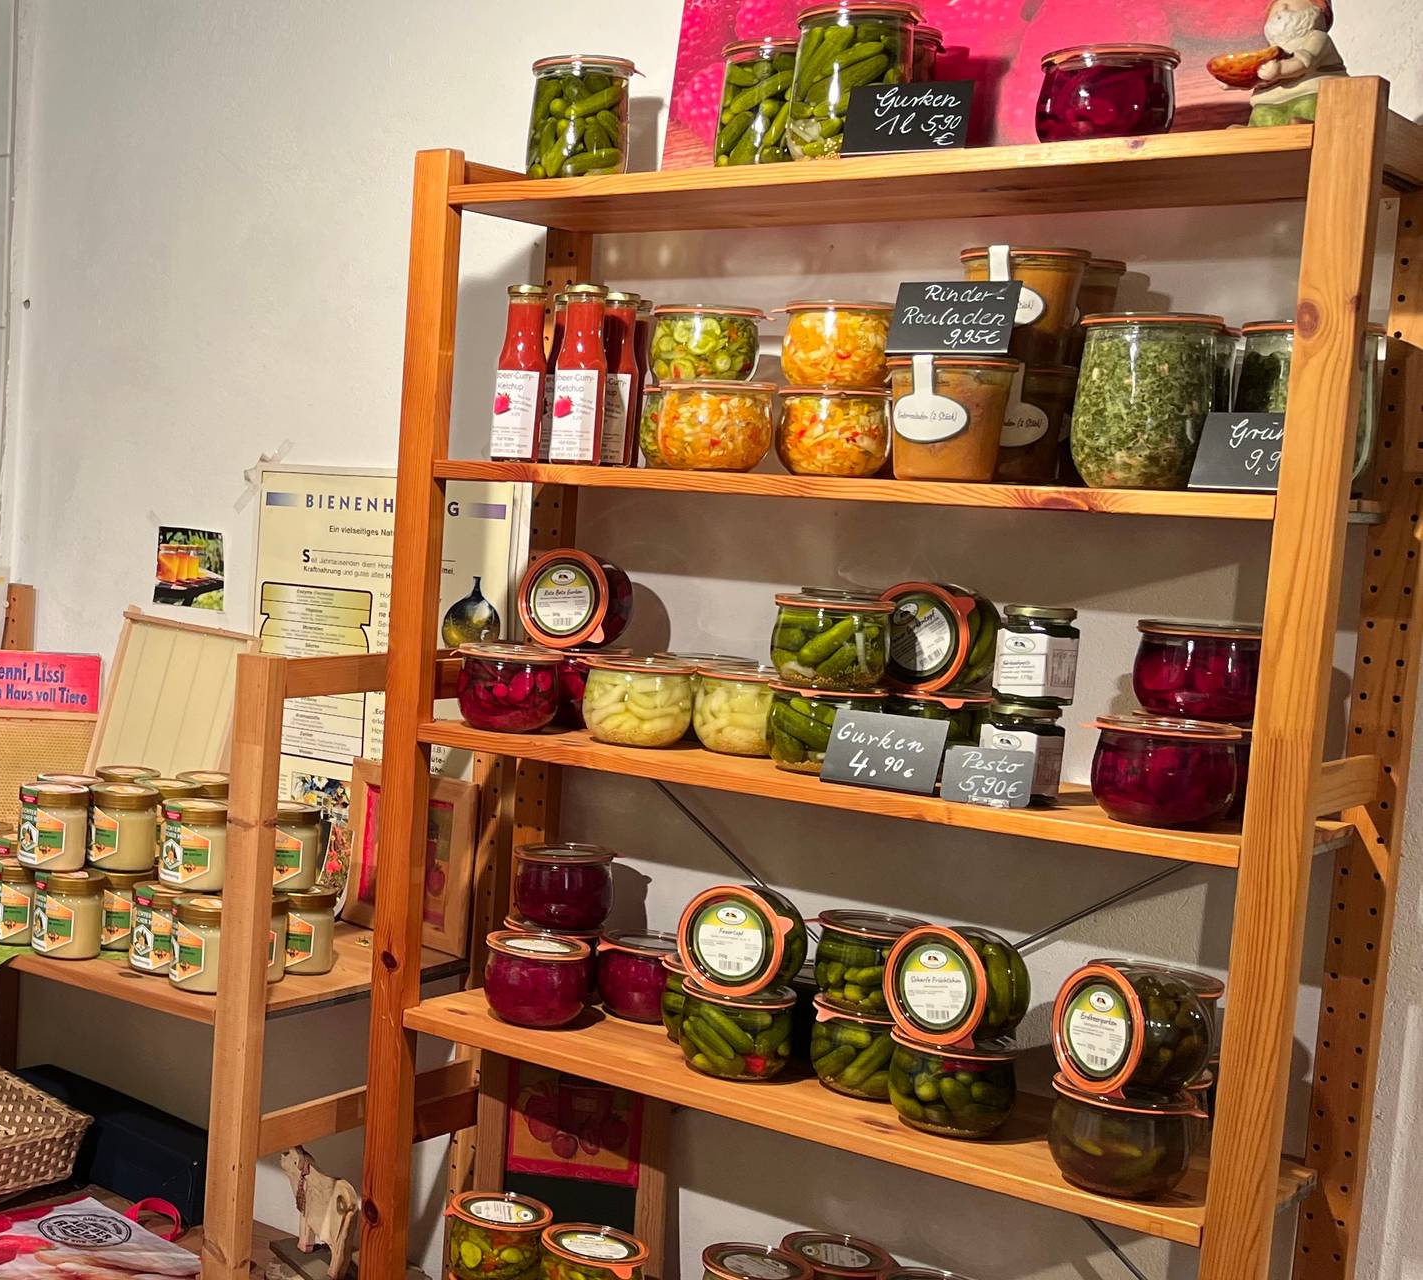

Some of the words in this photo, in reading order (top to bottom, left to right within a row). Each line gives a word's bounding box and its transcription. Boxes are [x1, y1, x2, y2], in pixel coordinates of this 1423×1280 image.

[875, 86, 961, 117] Gurken
[925, 283, 1005, 303] Rinder-
[902, 306, 1007, 326] Rouladen
[1245, 449, 1282, 476] 9,9
[329, 525, 340, 533] Ein
[341, 527, 379, 536] vielseitiges
[34, 663, 66, 683] Lissi
[6, 685, 34, 701] Haus
[36, 687, 56, 702] voll
[58, 687, 88, 705] Tiere
[837, 722, 925, 753] Gurken
[962, 752, 1025, 774] Pesto
